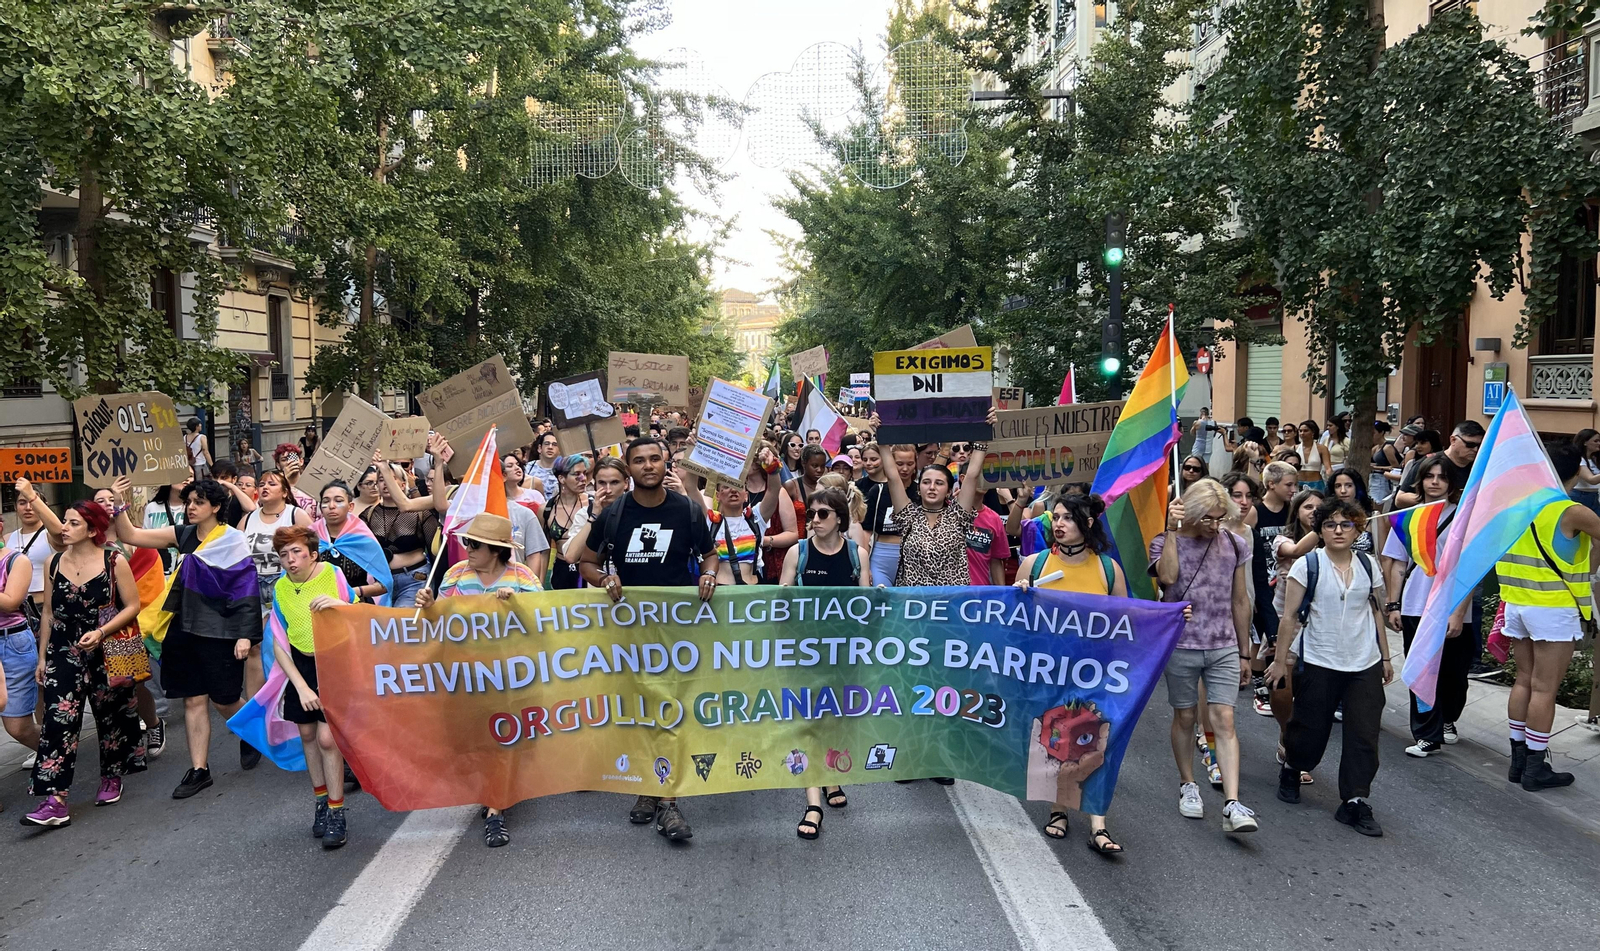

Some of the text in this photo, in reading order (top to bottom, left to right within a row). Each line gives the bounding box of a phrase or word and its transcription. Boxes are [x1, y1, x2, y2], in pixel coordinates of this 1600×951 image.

[895, 354, 984, 370] EXIGIMOS
[618, 375, 637, 387] FOR
[912, 373, 943, 393] DNI
[1486, 384, 1502, 399] AT
[116, 402, 154, 434] OLE
[1000, 418, 1031, 439] CALLE
[14, 451, 69, 466] SOMOS
[87, 438, 139, 479] COÑO
[982, 445, 1075, 483] ORGULLO
[1078, 456, 1102, 472] PROT
[0, 466, 70, 483] RCANCÍA
[370, 595, 1134, 645] MEMORIA HISTÓRICA LGBTIAQ+ DE GRANADA
[374, 636, 1130, 696] REIVINDICANDO NUESTROS BARRIOS
[488, 684, 1007, 746] ORGULLO GRANADA 2023
[741, 751, 755, 762] EL
[735, 759, 763, 779] FARO
